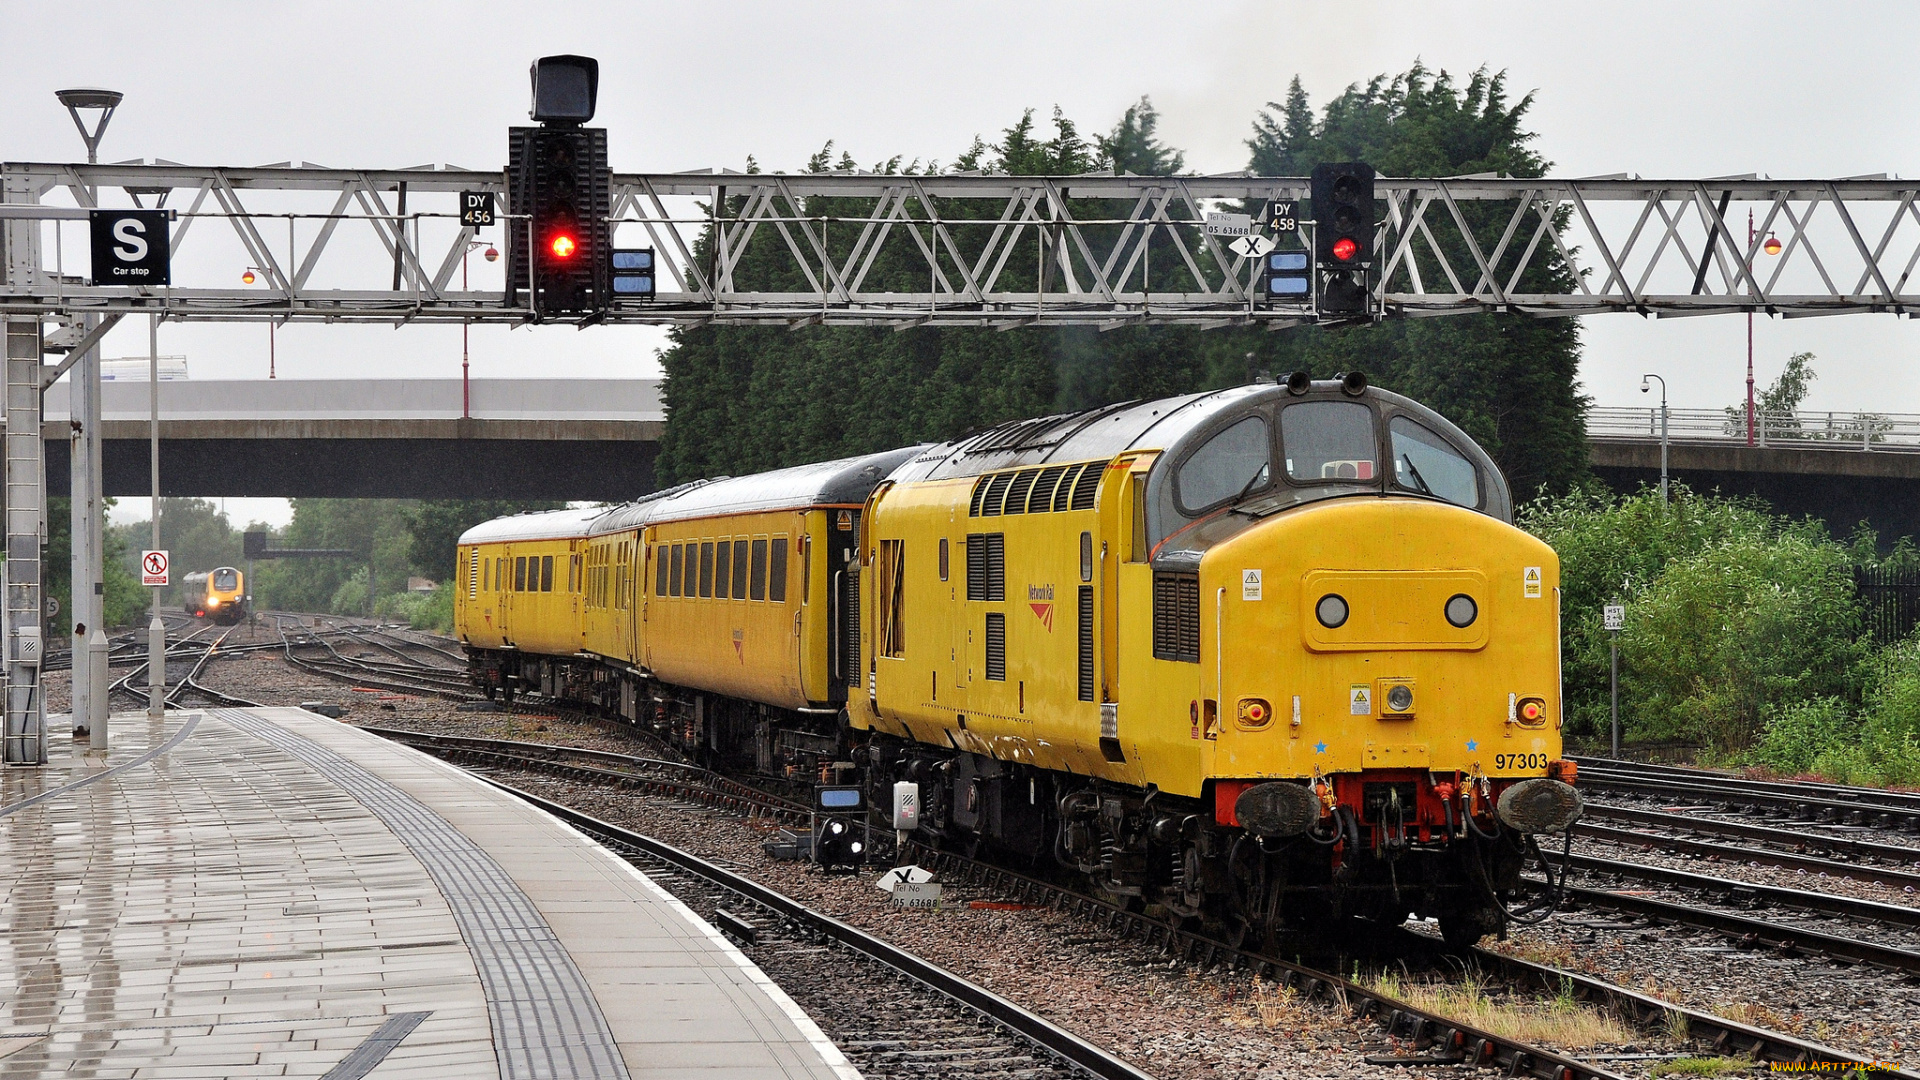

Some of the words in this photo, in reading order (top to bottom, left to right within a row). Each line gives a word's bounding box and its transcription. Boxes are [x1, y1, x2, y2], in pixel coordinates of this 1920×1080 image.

[467, 195, 486, 207] DY
[1274, 203, 1291, 216] DY
[464, 210, 491, 223] 456
[1208, 226, 1219, 234] 05
[1222, 226, 1249, 236] 63688
[1270, 218, 1295, 231] 458
[113, 218, 148, 262] S
[1245, 237, 1260, 255] X
[113, 266, 129, 275] Car
[130, 267, 150, 276] stop
[1495, 753, 1548, 770] 97303
[896, 884, 906, 892] Tel
[893, 898, 905, 907] 05
[909, 898, 938, 908] 63688
